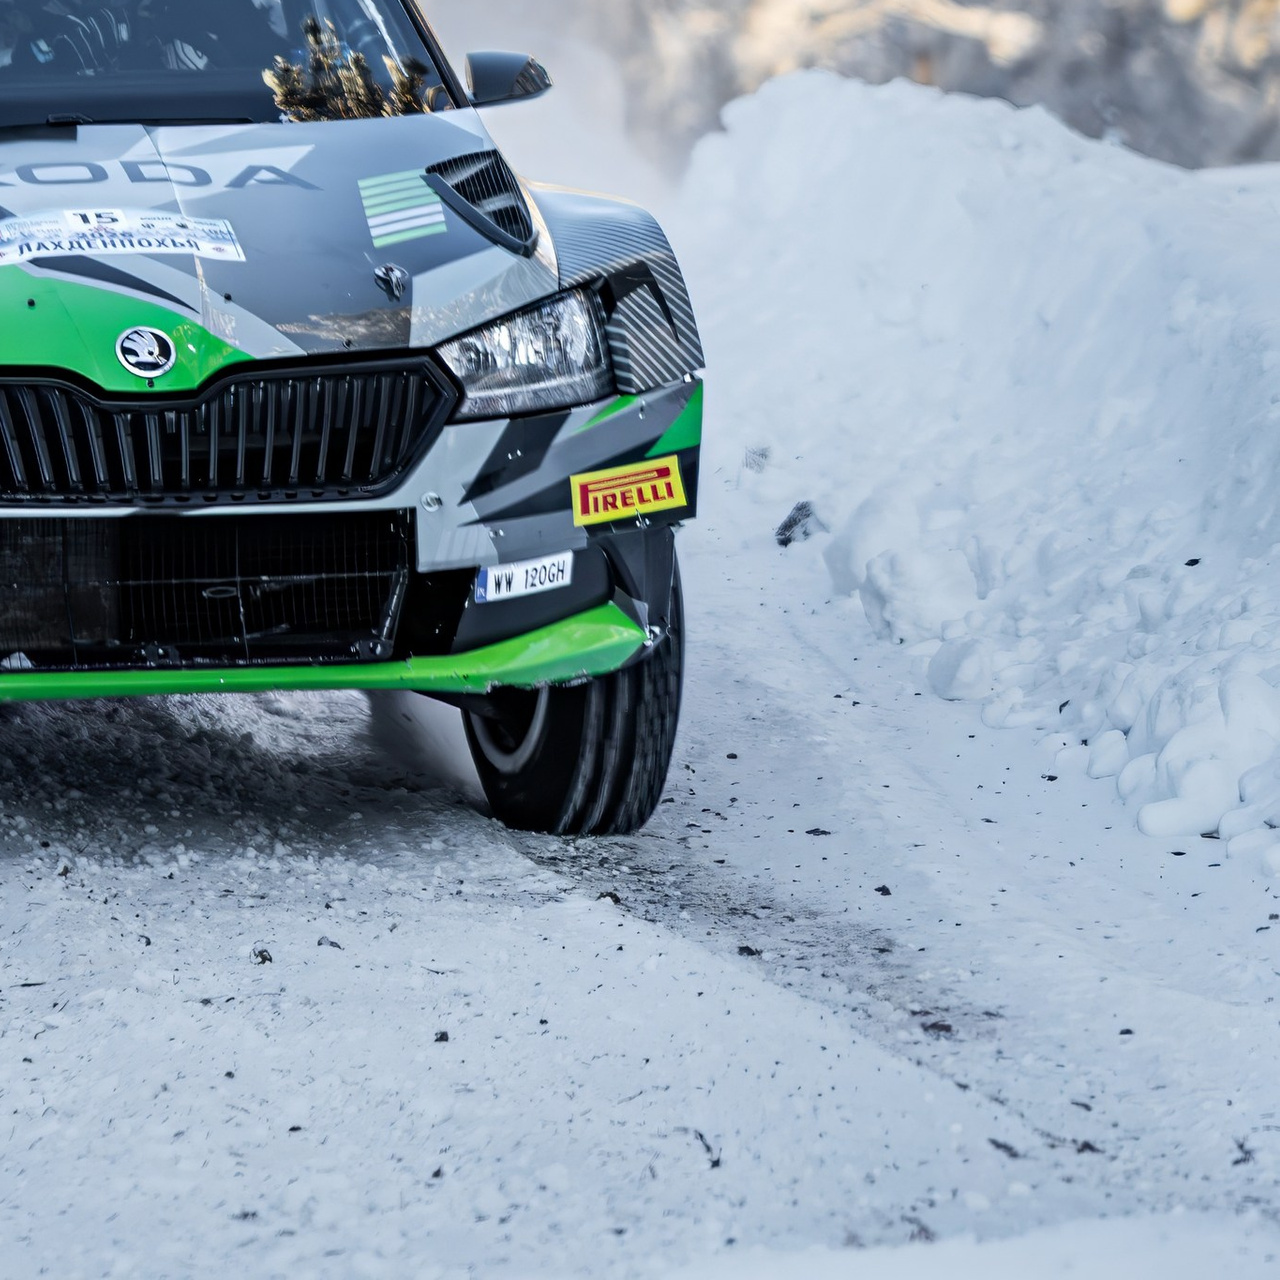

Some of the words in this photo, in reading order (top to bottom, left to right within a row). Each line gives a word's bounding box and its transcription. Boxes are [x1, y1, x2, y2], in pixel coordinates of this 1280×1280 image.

[72, 211, 119, 225] 15
[579, 465, 675, 516] PIRELLI
[493, 570, 514, 594] WW
[524, 560, 566, 590] 120GH
